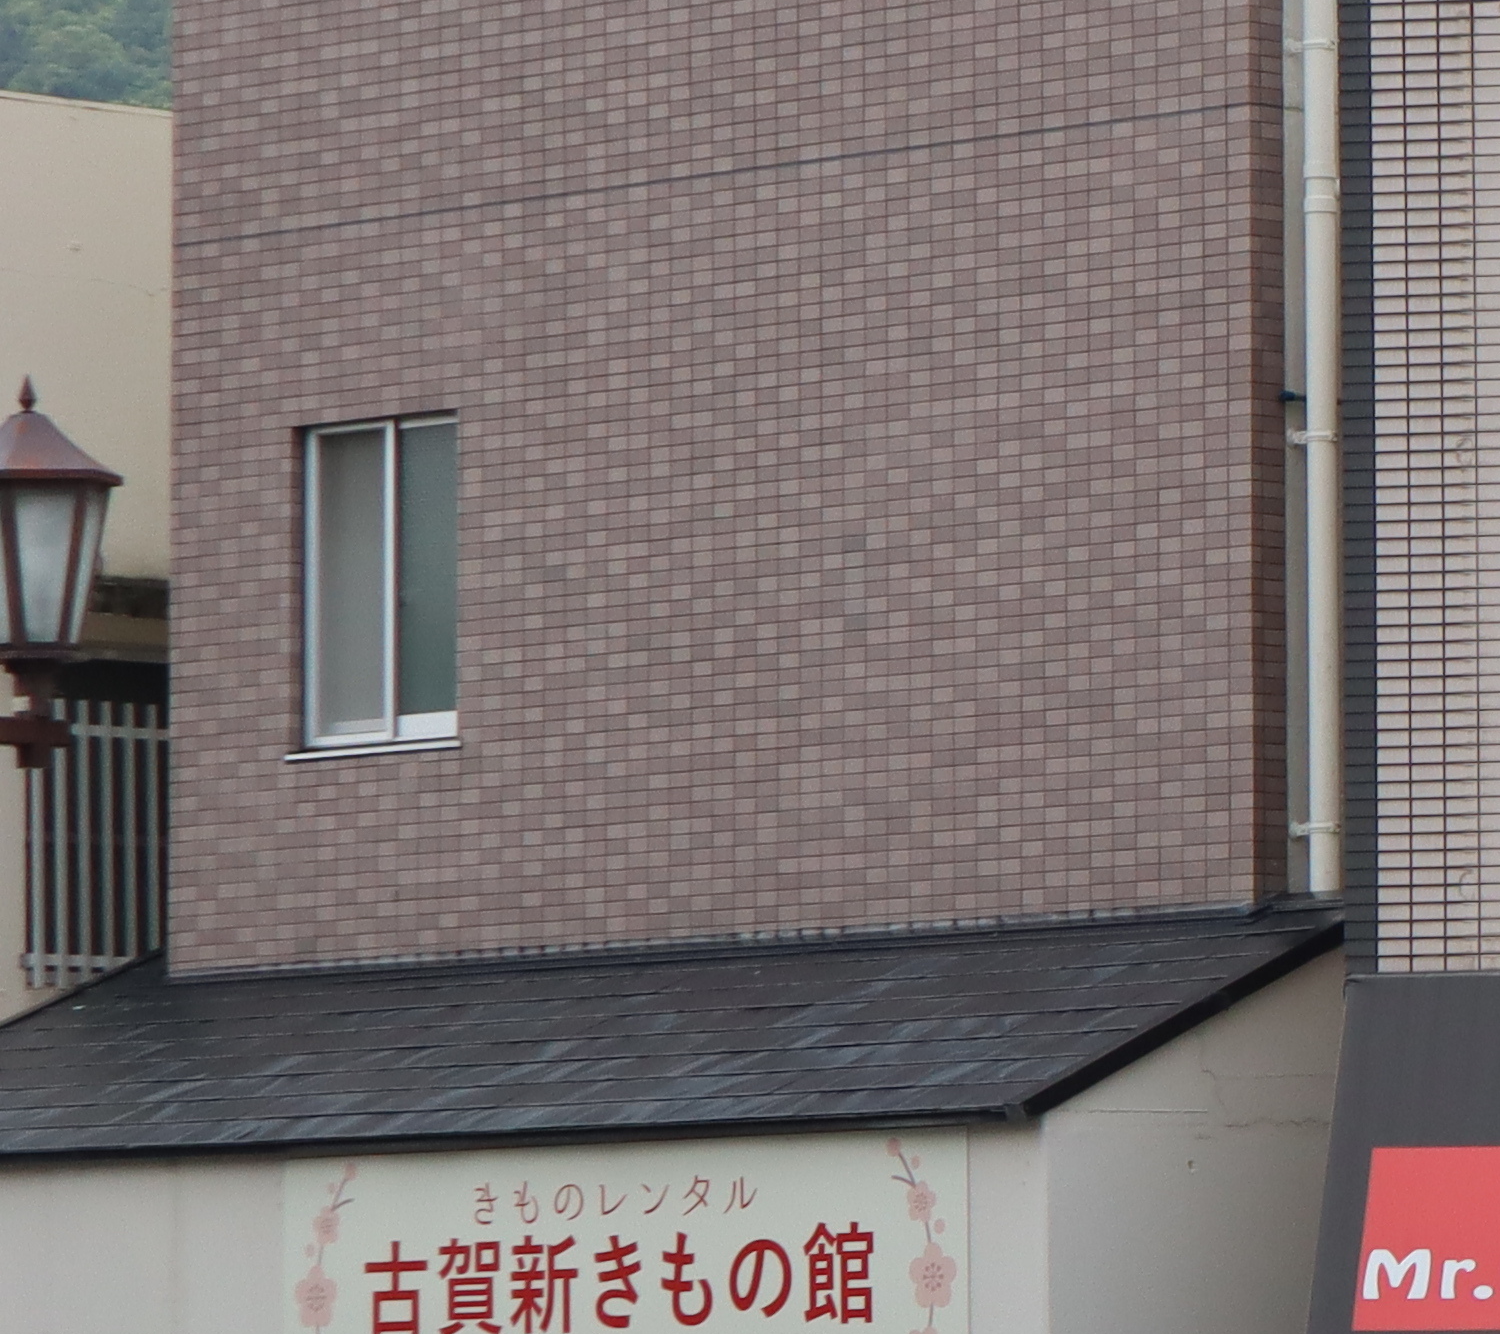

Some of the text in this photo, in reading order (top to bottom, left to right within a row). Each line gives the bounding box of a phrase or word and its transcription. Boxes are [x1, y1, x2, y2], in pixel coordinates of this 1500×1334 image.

[474, 1174, 758, 1226] きものレンタル
